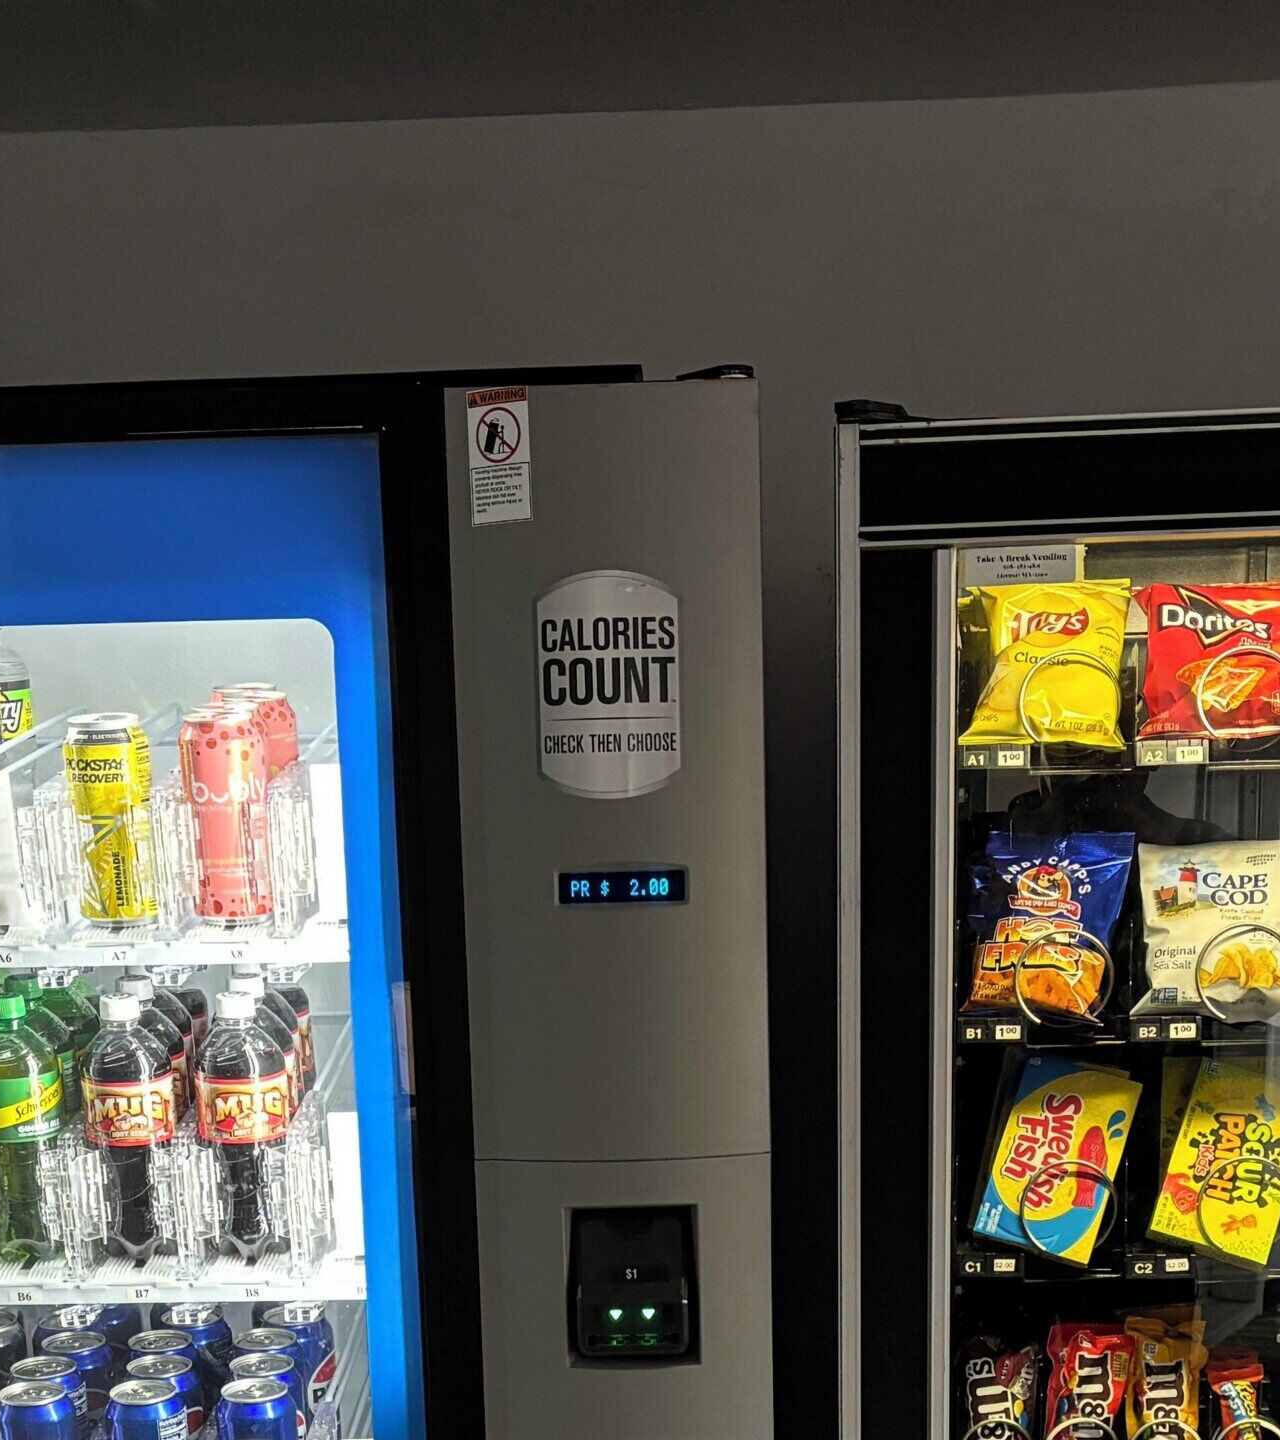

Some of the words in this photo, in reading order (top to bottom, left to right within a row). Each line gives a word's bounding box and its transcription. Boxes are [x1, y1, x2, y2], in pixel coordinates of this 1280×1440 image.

[480, 388, 524, 402] WARNING
[1033, 553, 1067, 561] Vending
[1012, 608, 1088, 637] Lay's
[1161, 604, 1269, 639] Doritos
[541, 616, 675, 652] CALORIES
[1014, 652, 1069, 667] Classic
[543, 656, 675, 706] COUNT
[544, 734, 584, 755] CHECK
[589, 733, 622, 754] THEN
[627, 732, 677, 753] CHOOSE
[968, 755, 984, 765] A1
[1145, 752, 1163, 762] A2
[72, 773, 126, 783] RECOVERY
[116, 851, 126, 908] LEMONADE
[1002, 858, 1042, 884] ANDY
[1047, 856, 1092, 895] CAPP'S
[1202, 872, 1268, 889] CAPE
[571, 880, 590, 897] PR
[600, 879, 610, 897] $
[629, 878, 669, 896] 2.00
[1210, 889, 1268, 906] COD
[1154, 946, 1196, 958] Original
[1153, 961, 1171, 972] Sea
[1173, 959, 1192, 970] Salt
[966, 1028, 982, 1038] B1
[1139, 1027, 1156, 1038] B2
[94, 1096, 163, 1121] MUG
[215, 1093, 281, 1121] MUG
[1002, 1115, 1050, 1183] Fish
[1024, 1093, 1083, 1210] Swedish
[1205, 1113, 1250, 1204] PATCH
[1194, 1143, 1215, 1177] Kids
[1234, 1123, 1270, 1205] SOUR
[965, 1261, 980, 1273] C1
[1135, 1263, 1152, 1274] C2
